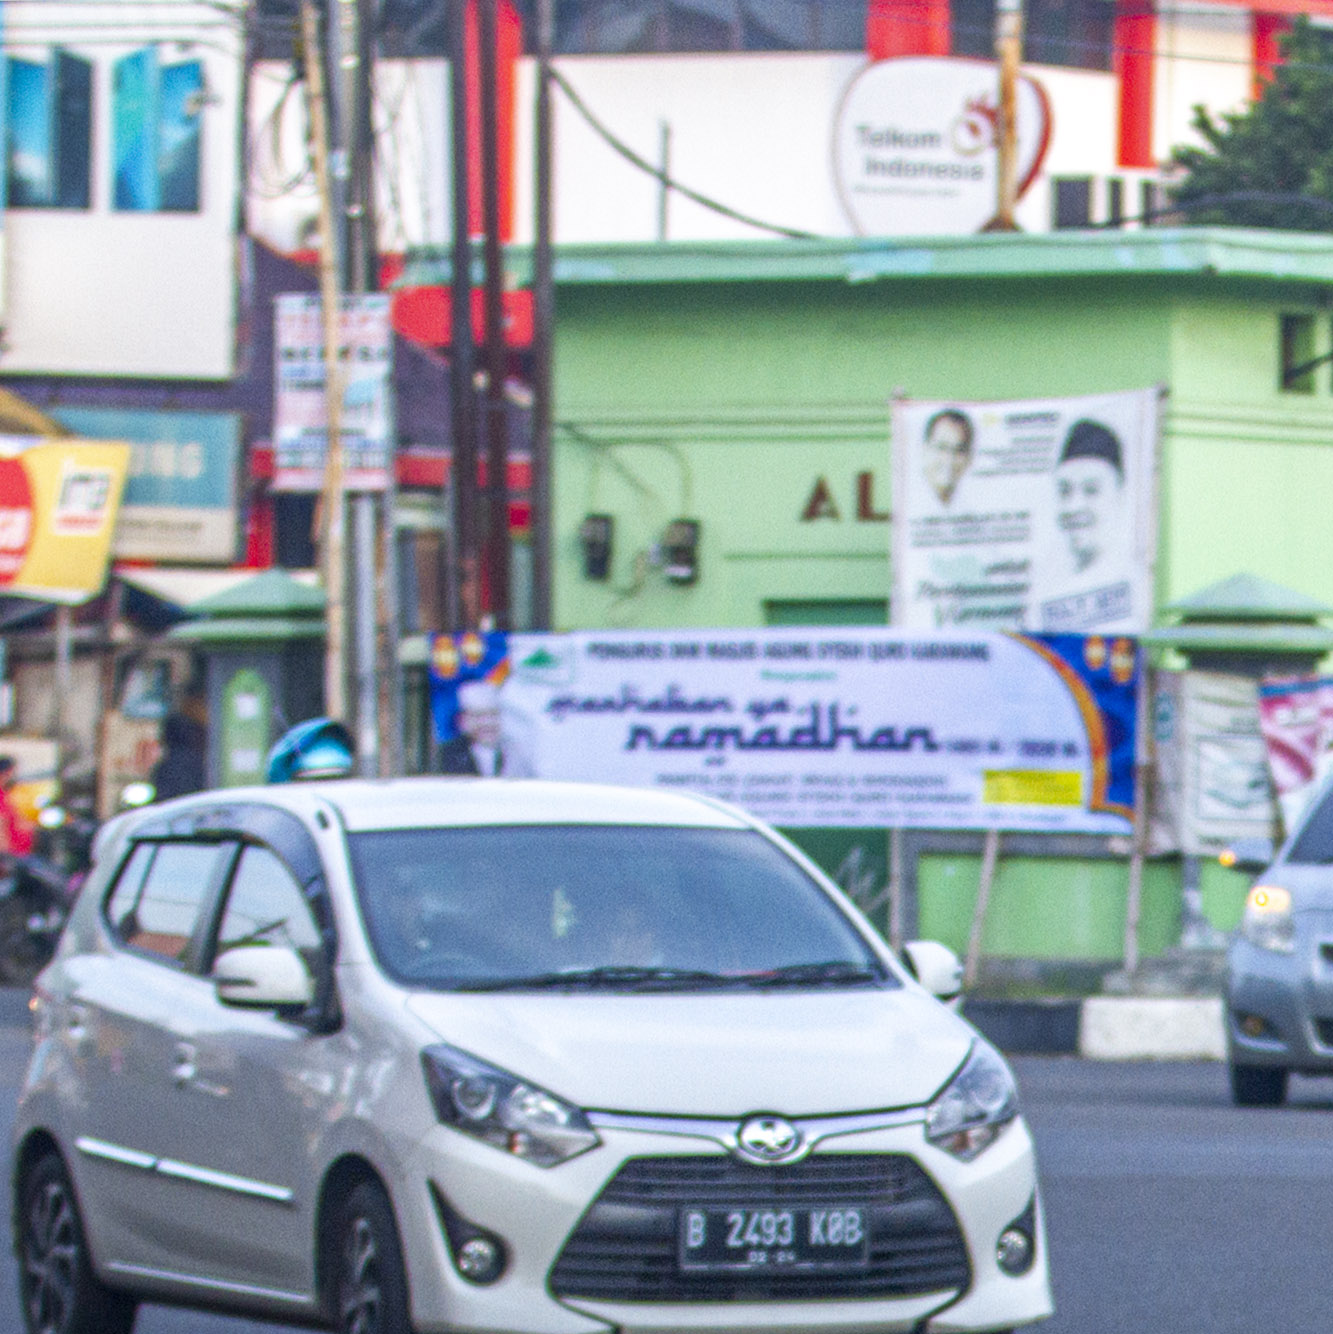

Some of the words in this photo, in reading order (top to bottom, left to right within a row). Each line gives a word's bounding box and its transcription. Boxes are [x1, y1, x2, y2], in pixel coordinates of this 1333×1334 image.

[856, 123, 941, 148] Telkom
[864, 157, 984, 181] Indonesia
[623, 701, 938, 756] ramadhan
[687, 1212, 706, 1248] B
[727, 1211, 794, 1247] 2493
